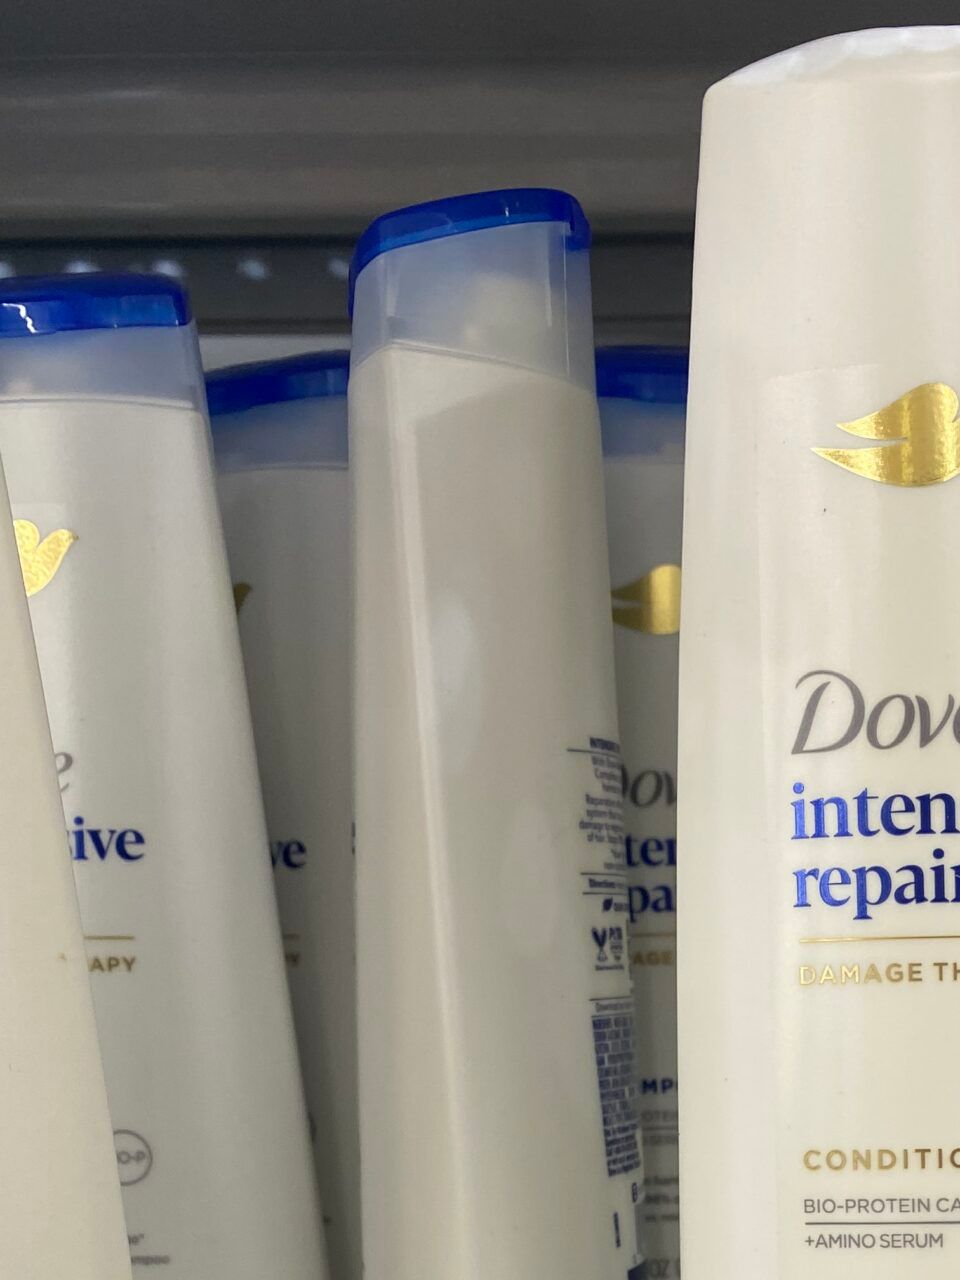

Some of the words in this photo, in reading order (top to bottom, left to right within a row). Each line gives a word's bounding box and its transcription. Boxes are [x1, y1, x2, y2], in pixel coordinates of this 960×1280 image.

[799, 962, 922, 985] DAMAGE
[803, 1198, 931, 1214] BIO-PROTEIN
[805, 1234, 876, 1249] +AMINO
[880, 1233, 944, 1248] SERUM
